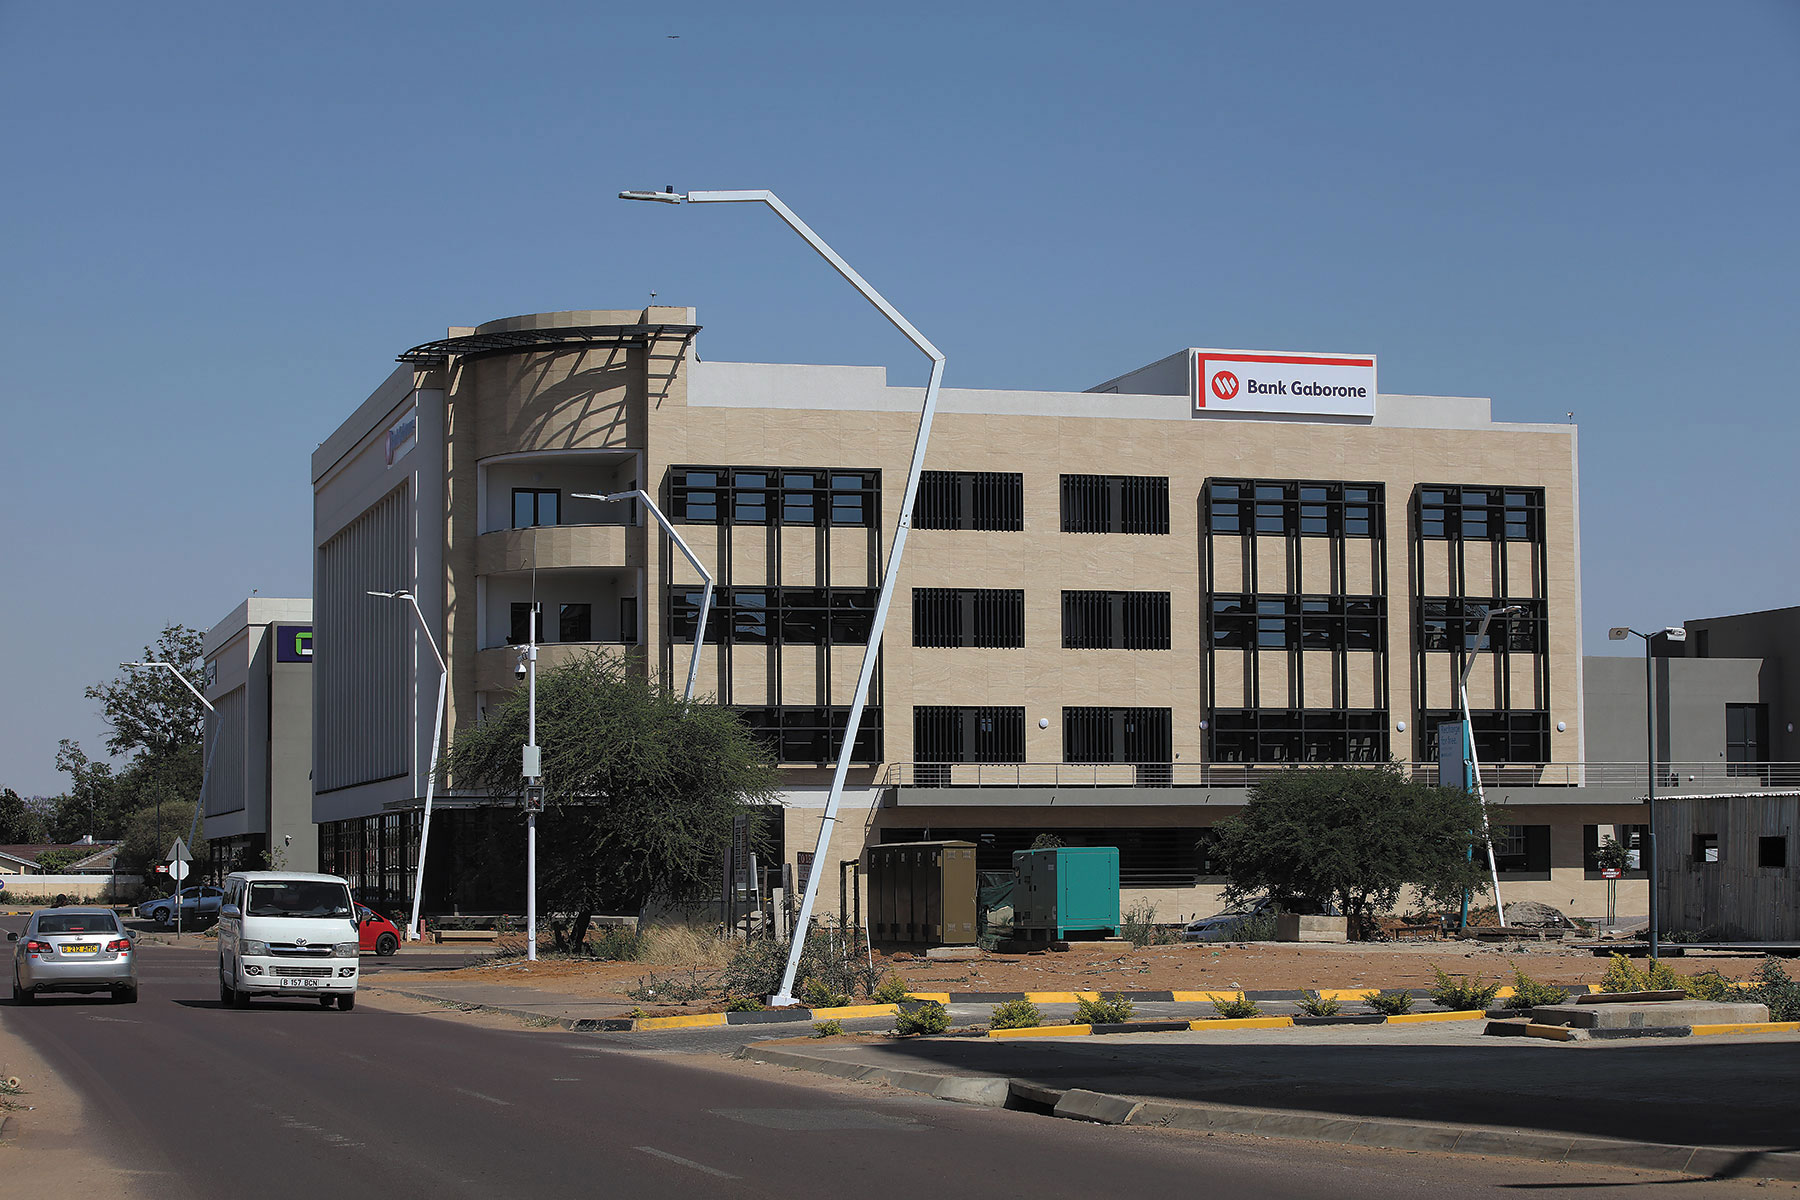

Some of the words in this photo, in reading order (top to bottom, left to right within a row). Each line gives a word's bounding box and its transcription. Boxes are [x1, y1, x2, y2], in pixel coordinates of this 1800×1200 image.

[1247, 379, 1287, 395] Bank
[1290, 381, 1367, 398] Gaborone
[283, 978, 288, 986] B
[304, 979, 318, 987] BCN
